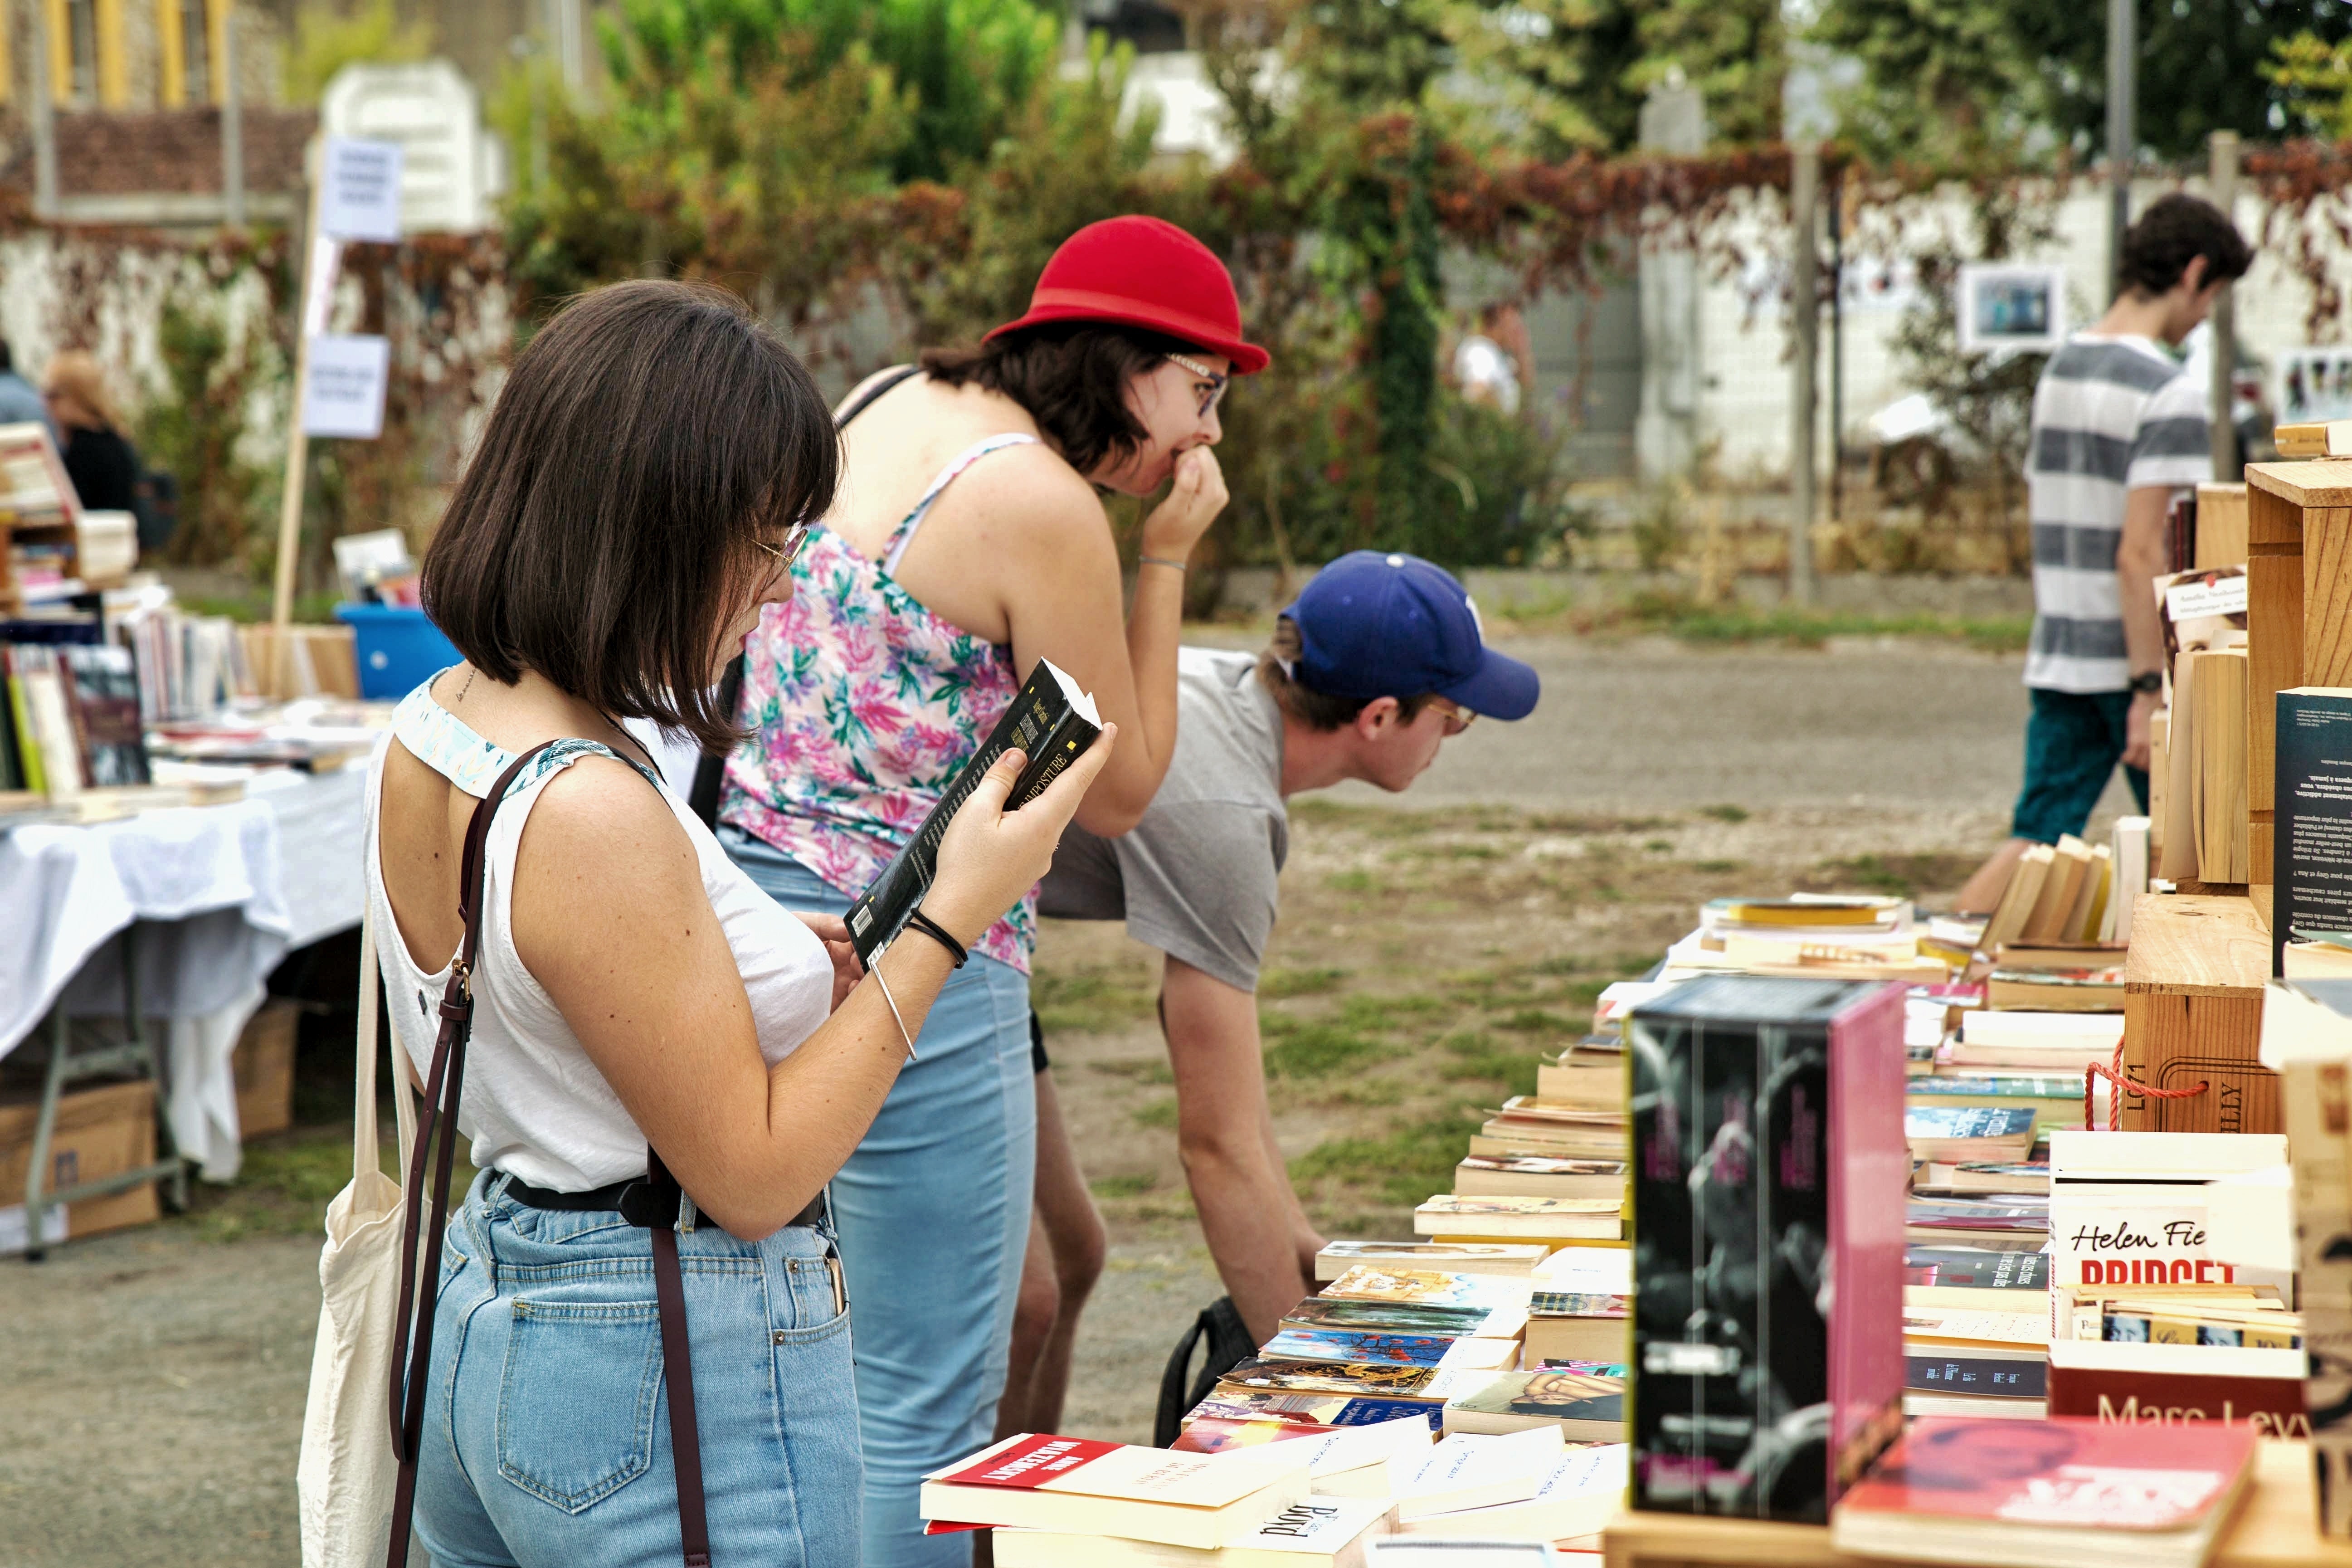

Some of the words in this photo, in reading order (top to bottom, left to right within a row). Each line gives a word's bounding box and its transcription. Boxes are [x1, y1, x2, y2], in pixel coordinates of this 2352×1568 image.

[2071, 1221, 2158, 1251] Helen
[2163, 1221, 2206, 1246] Fie
[2017, 1271, 2038, 1285] choses
[2097, 1394, 2207, 1428] Marc
[981, 1440, 1082, 1480] WIAZEMSKY
[1042, 1455, 1084, 1471] ANNE
[1259, 1505, 1338, 1538] Boyd
